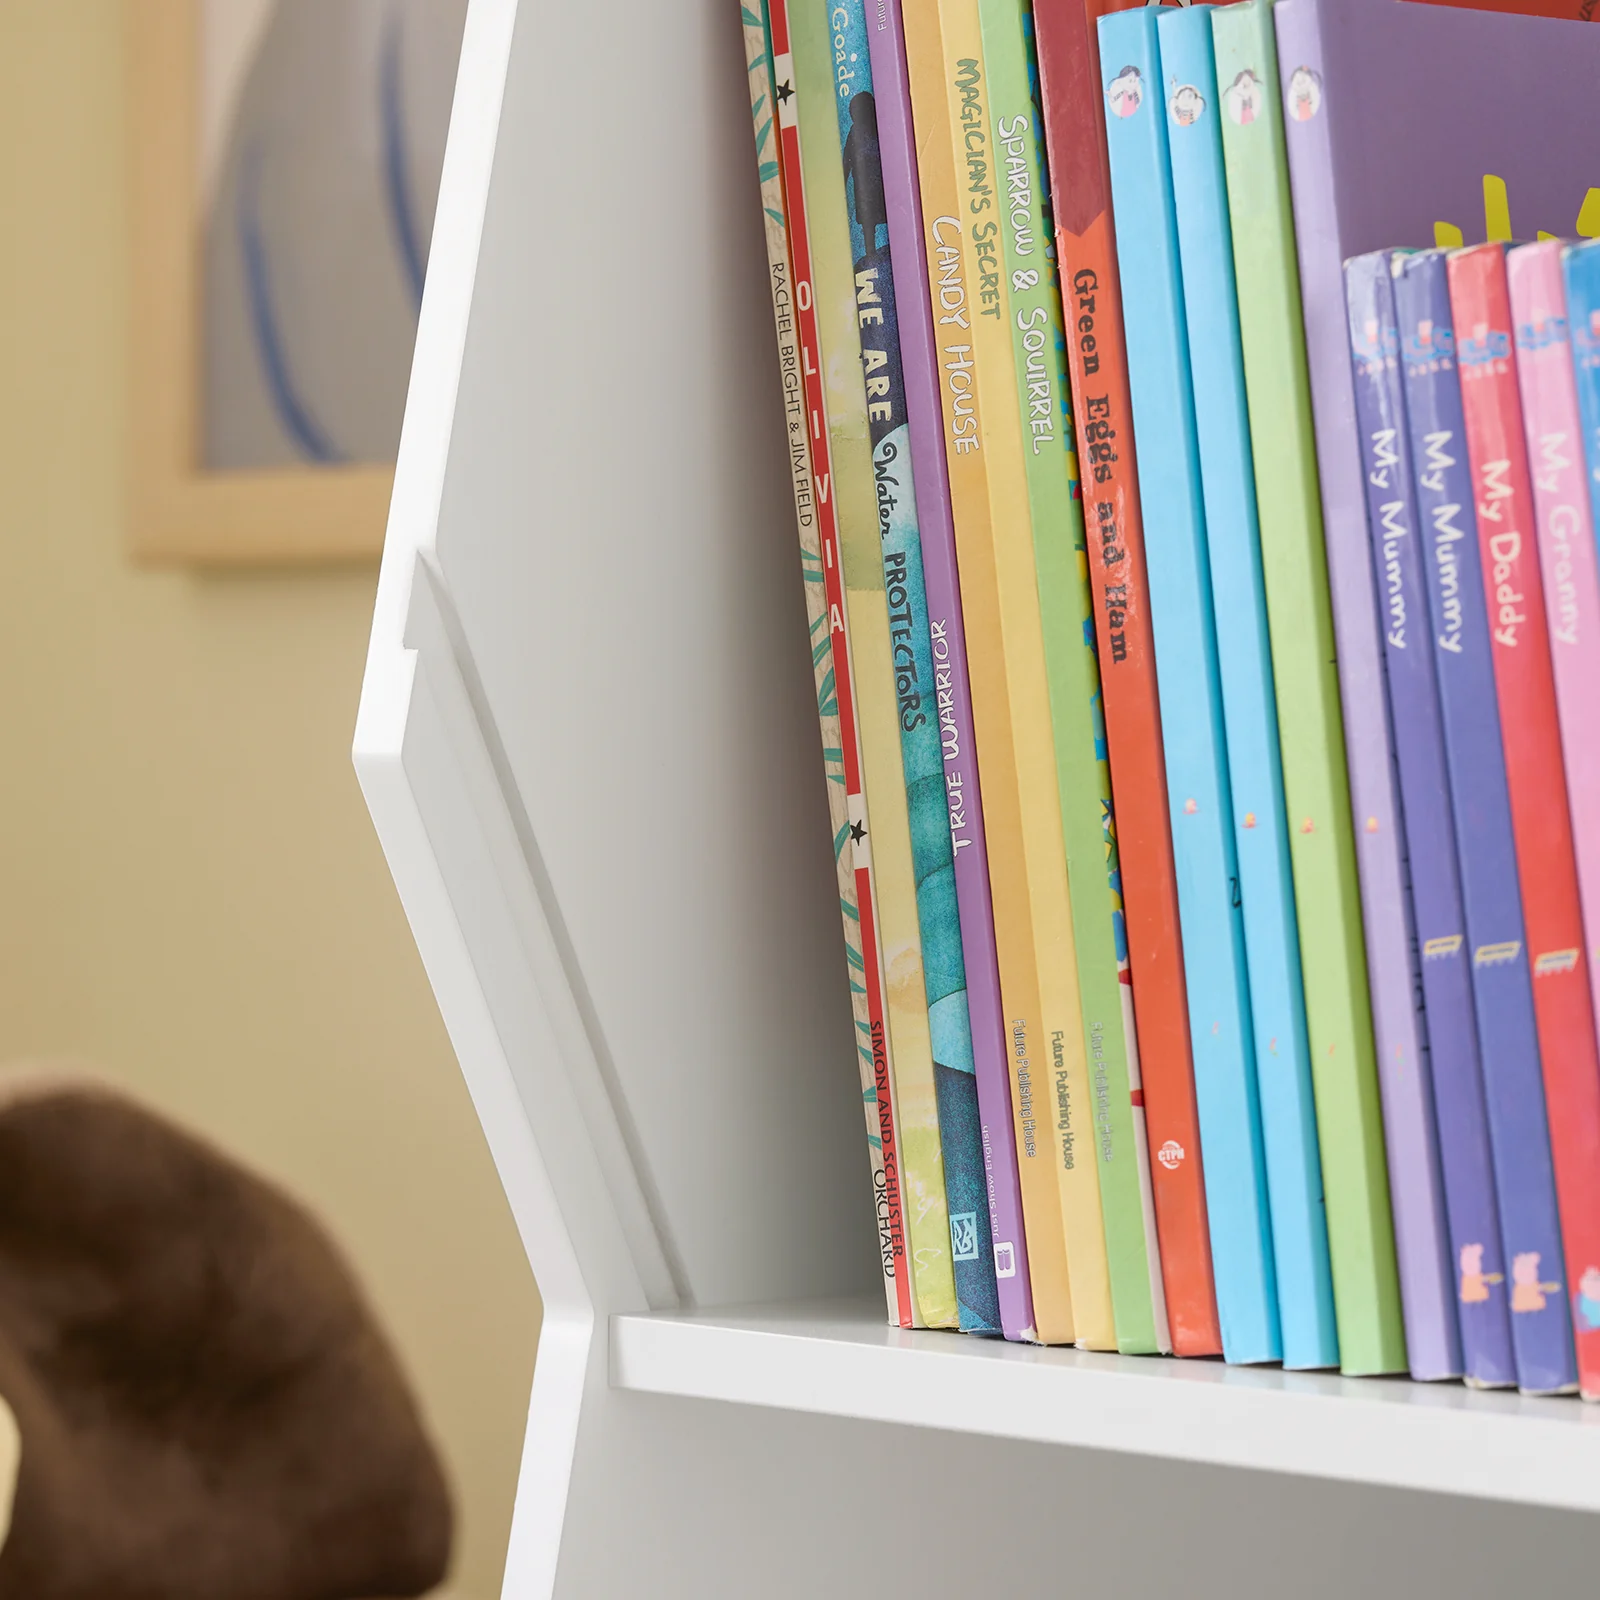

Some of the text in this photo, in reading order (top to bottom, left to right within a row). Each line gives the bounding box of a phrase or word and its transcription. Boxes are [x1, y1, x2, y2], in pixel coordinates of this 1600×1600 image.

[832, 7, 855, 97] Goade
[954, 58, 1000, 320] MAGICIAN'S SECRET
[998, 114, 1054, 455] SPARROW & SQUIRREL
[772, 262, 812, 527] RACHEL BRIGHT & JIM FIELD
[855, 267, 884, 328] WE
[863, 349, 892, 424] ARE
[932, 215, 980, 455] CANDY HOUSE
[796, 280, 844, 634] OLIVIA
[874, 441, 899, 540] Water
[1073, 268, 1128, 664] Green Eggs and Ham
[1370, 428, 1408, 649] My Mummy
[1420, 430, 1464, 653] My Mummy
[1479, 459, 1526, 647] My Daddy
[1537, 432, 1581, 644] My Granny
[931, 619, 972, 857] TRUE WARRIOR
[871, 1020, 903, 1257] SIMON AND SCHUSTER
[1012, 1019, 1036, 1158] Future Publishing House
[1051, 1030, 1075, 1170] Future Publishing House
[1090, 1021, 1103, 1059] Future
[1095, 1062, 1110, 1121] Publishing
[982, 1125, 1000, 1237] Just Show English
